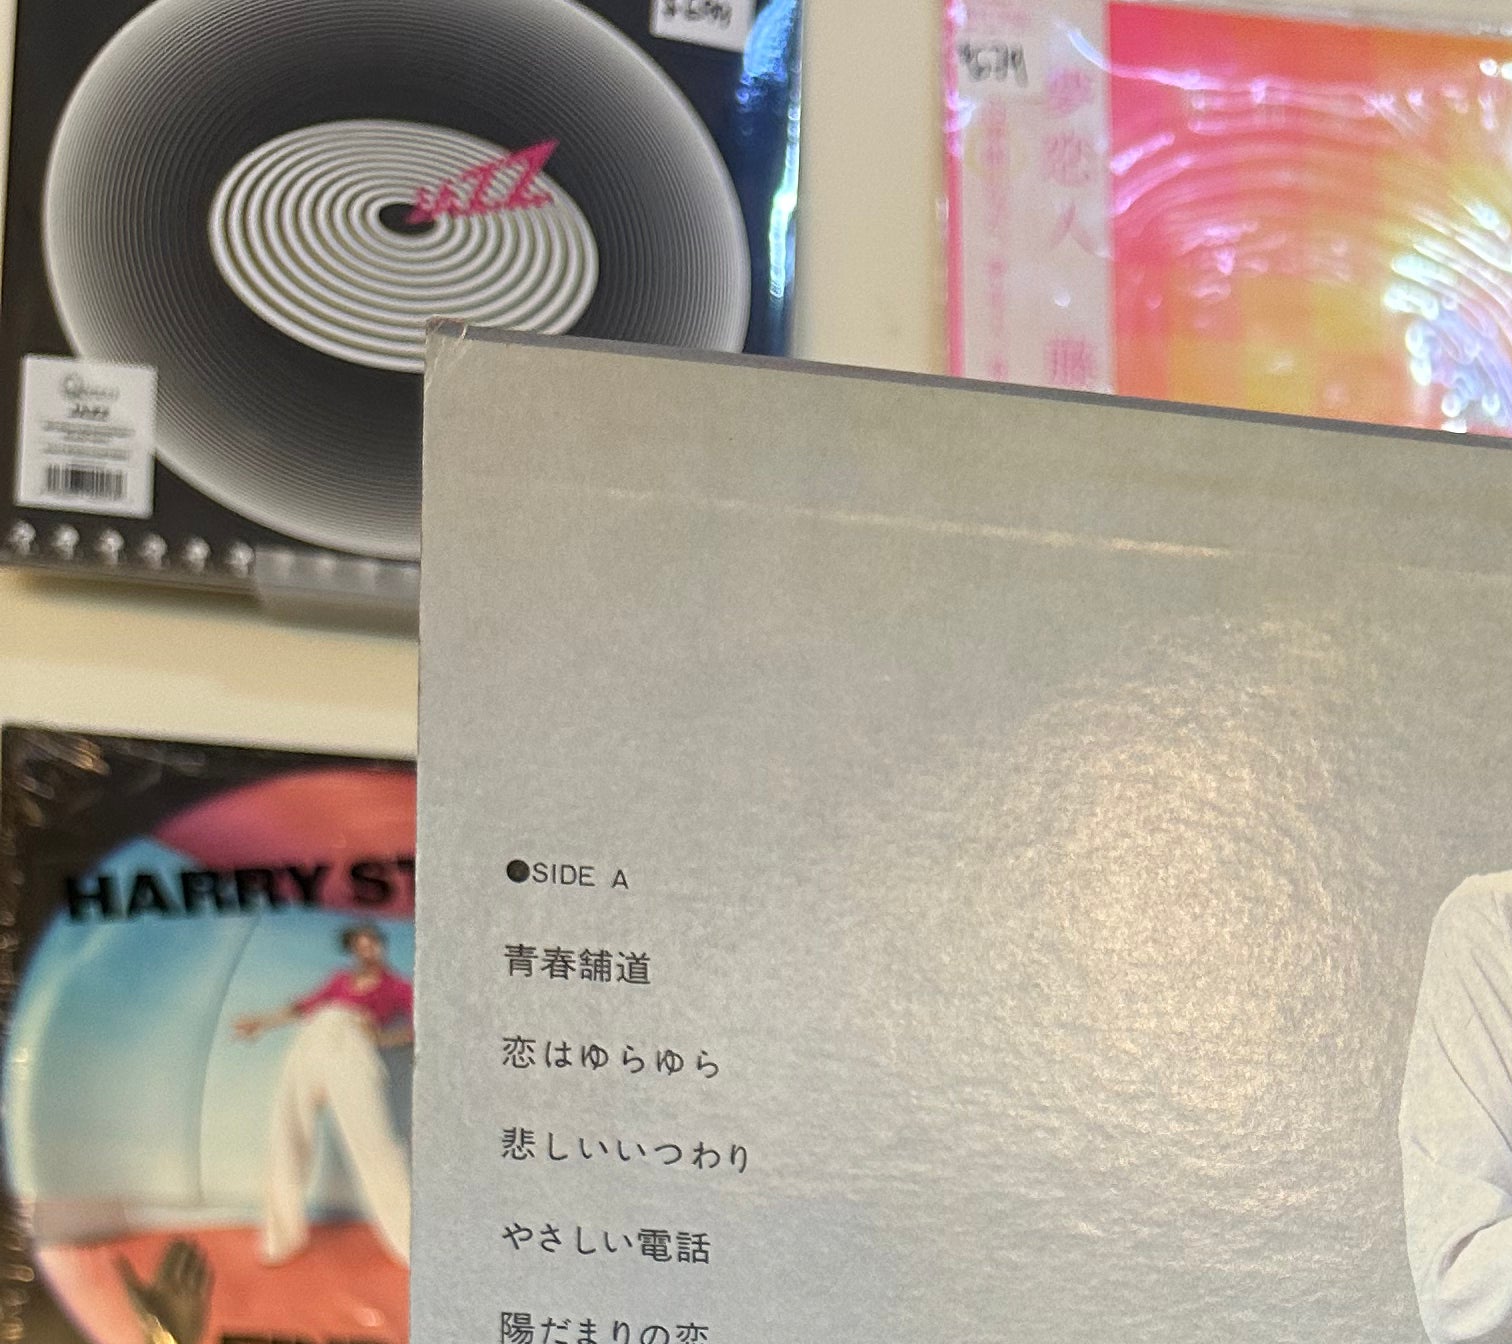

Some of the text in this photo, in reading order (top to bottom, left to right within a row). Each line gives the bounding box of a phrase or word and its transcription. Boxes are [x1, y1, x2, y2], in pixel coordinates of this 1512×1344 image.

[66, 862, 328, 922] HARRY
[611, 868, 631, 890] A
[503, 944, 652, 985] 青春舗道
[501, 1036, 721, 1079] 恋はゆらゆら
[500, 1126, 750, 1175] 悲しいいつわり
[501, 1221, 711, 1265] やさしい電話
